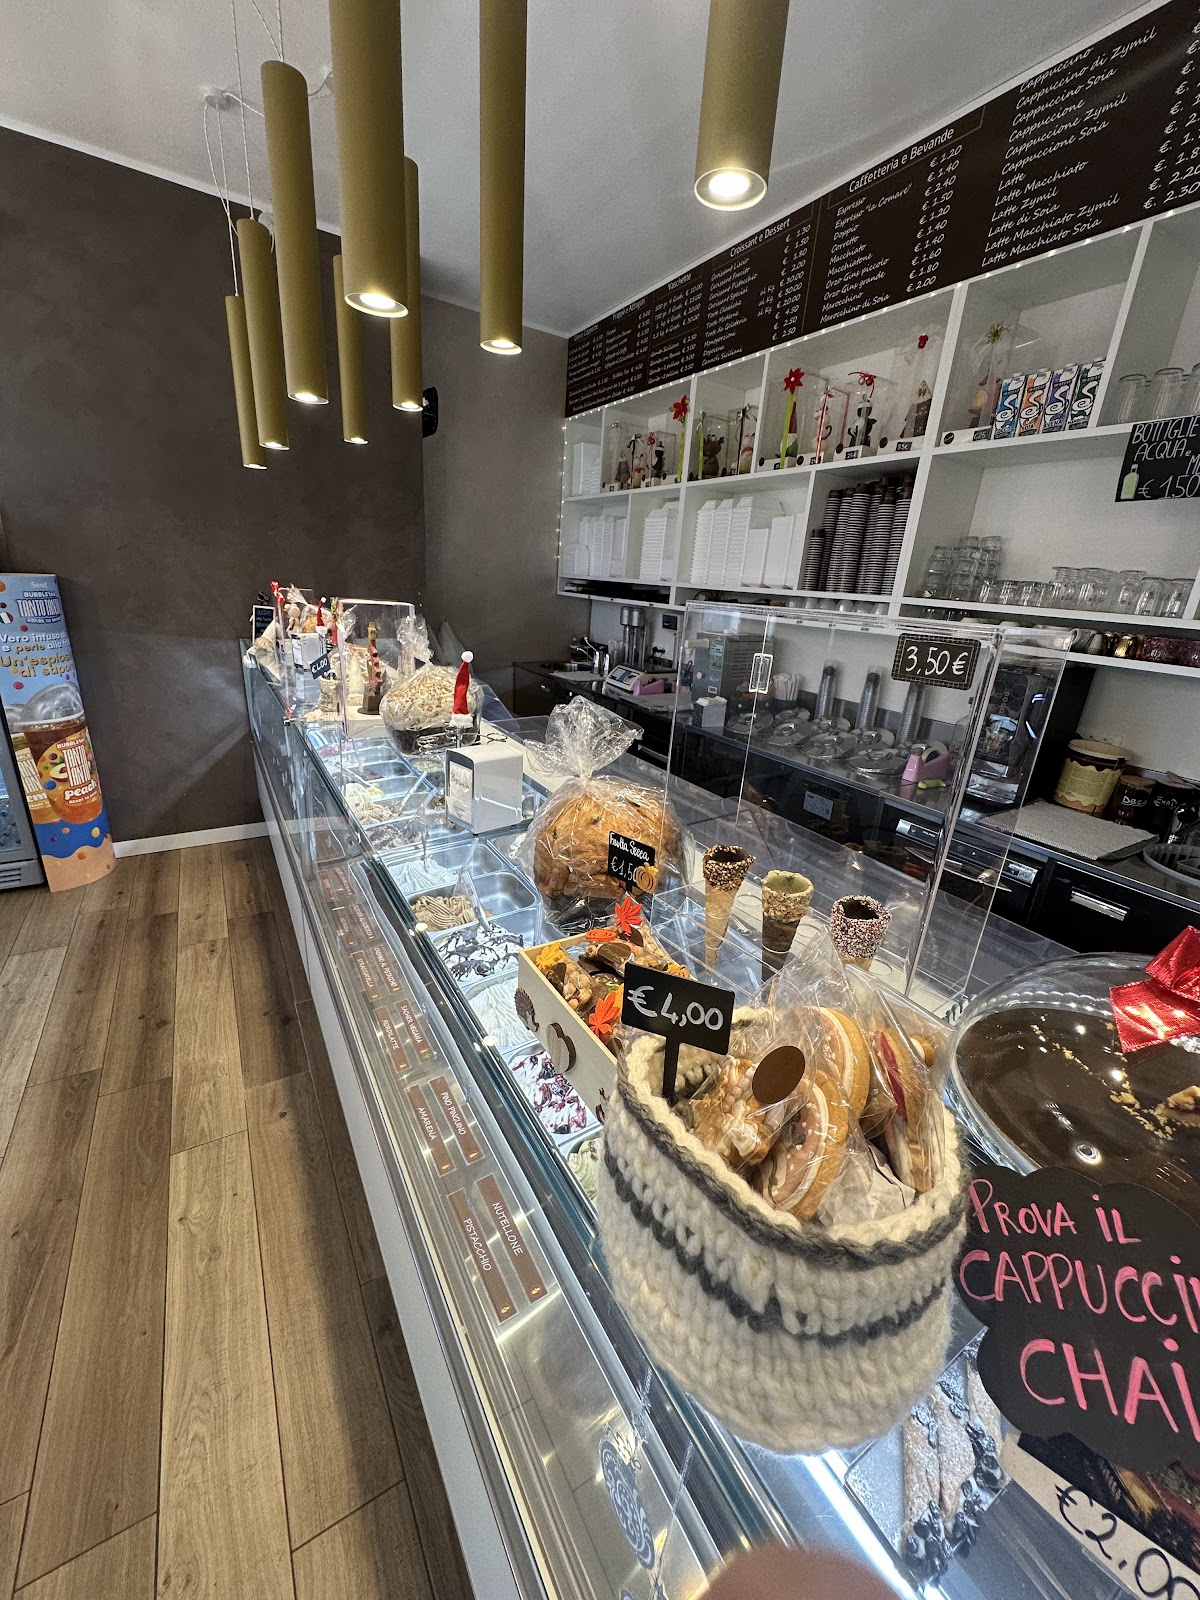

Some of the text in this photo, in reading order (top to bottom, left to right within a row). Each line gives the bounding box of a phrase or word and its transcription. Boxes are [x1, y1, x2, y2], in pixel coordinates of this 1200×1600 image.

[1016, 26, 1157, 110] Cappuccino di Zymil
[1019, 47, 1094, 93] Cappuccino
[1012, 67, 1118, 126] Cappuccino Soia
[1005, 92, 1128, 159] Cappuccione Zymil
[1008, 99, 1085, 143] Cappuccione
[940, 145, 963, 159] 1.20
[1001, 119, 1109, 175] Cappuccione Soia
[1175, 147, 1200, 165] 1.8
[849, 128, 954, 192] Caffetteria e Bevande
[937, 160, 960, 177] 1.40
[935, 175, 957, 192] 2.40
[994, 161, 1089, 207] Latte Macchiato
[997, 171, 1026, 191] Latte
[1163, 181, 1200, 203] 2.30
[836, 196, 867, 217] Espresso
[932, 190, 954, 207] 1.50
[991, 186, 1059, 222] Latte Zymil
[834, 209, 865, 229] Espresso
[929, 204, 951, 221] 1.20
[985, 193, 1120, 253] Latte Macchiato Zymil
[988, 203, 1060, 237] Latte di Soia
[730, 218, 790, 257] Croissant e Dessert
[833, 224, 859, 242] Doppio
[926, 219, 948, 235] 1.40
[831, 236, 860, 253] Corretto
[924, 233, 945, 249] 1.40
[981, 218, 1103, 268] Latte Macchiato Soia
[827, 252, 873, 277] Macchiatone
[828, 244, 867, 265] Macchiato
[921, 247, 942, 262] 1.60
[825, 277, 843, 290] Orzo
[861, 257, 890, 276] piccolo
[918, 261, 939, 276] 1.80
[823, 289, 840, 301] Orzo
[858, 270, 886, 289] grande
[915, 276, 937, 290] 2.00
[820, 293, 890, 324] Marocchino di Soia
[822, 291, 864, 312] Marocchino
[1132, 416, 1200, 444] BOTTIGLIE
[1134, 438, 1187, 461] ACQUA
[1138, 475, 1200, 499] € 1,50
[0, 634, 29, 643] Vero
[32, 632, 60, 642] infuso
[16, 643, 45, 655] perle
[47, 641, 62, 649] alla
[19, 666, 36, 677] di
[65, 779, 97, 800] peach
[629, 841, 649, 861] Secca
[382, 1019, 400, 1050] FIORDILATTE
[400, 1005, 423, 1044] SACHER VEGANA
[417, 1106, 436, 1141] AMARENA
[969, 1178, 1077, 1236] PROVA
[492, 1202, 524, 1256] NUTELLONE
[463, 1217, 492, 1272] PISTACCHIO
